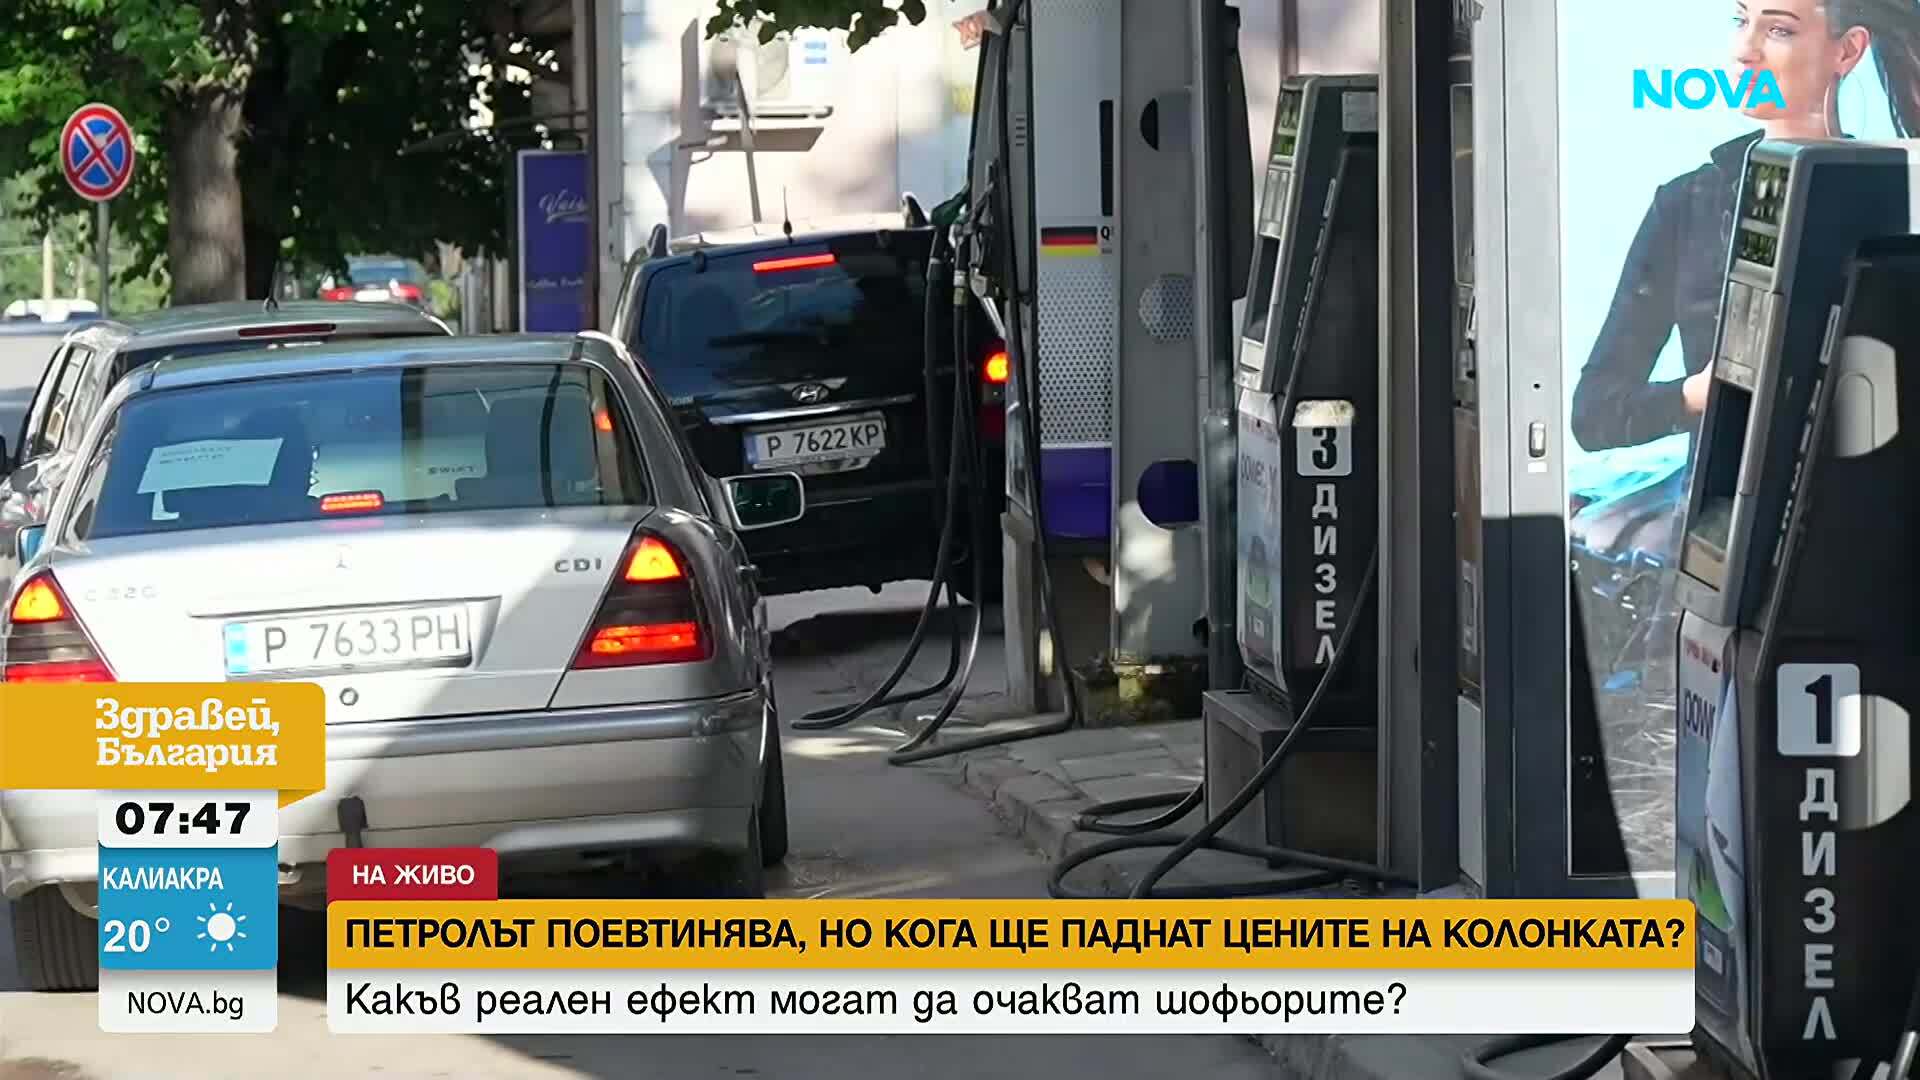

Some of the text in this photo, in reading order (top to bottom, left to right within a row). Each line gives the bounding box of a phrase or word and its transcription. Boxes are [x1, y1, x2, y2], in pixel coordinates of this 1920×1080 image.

[767, 436, 781, 458] P
[1312, 427, 1337, 470] 3
[554, 557, 602, 573] CDI
[1311, 483, 1338, 665] ДИЗЕЛ
[265, 627, 286, 663] P
[1805, 674, 1832, 744] 1
[1799, 768, 1838, 1040] ДИЗЕЛ
